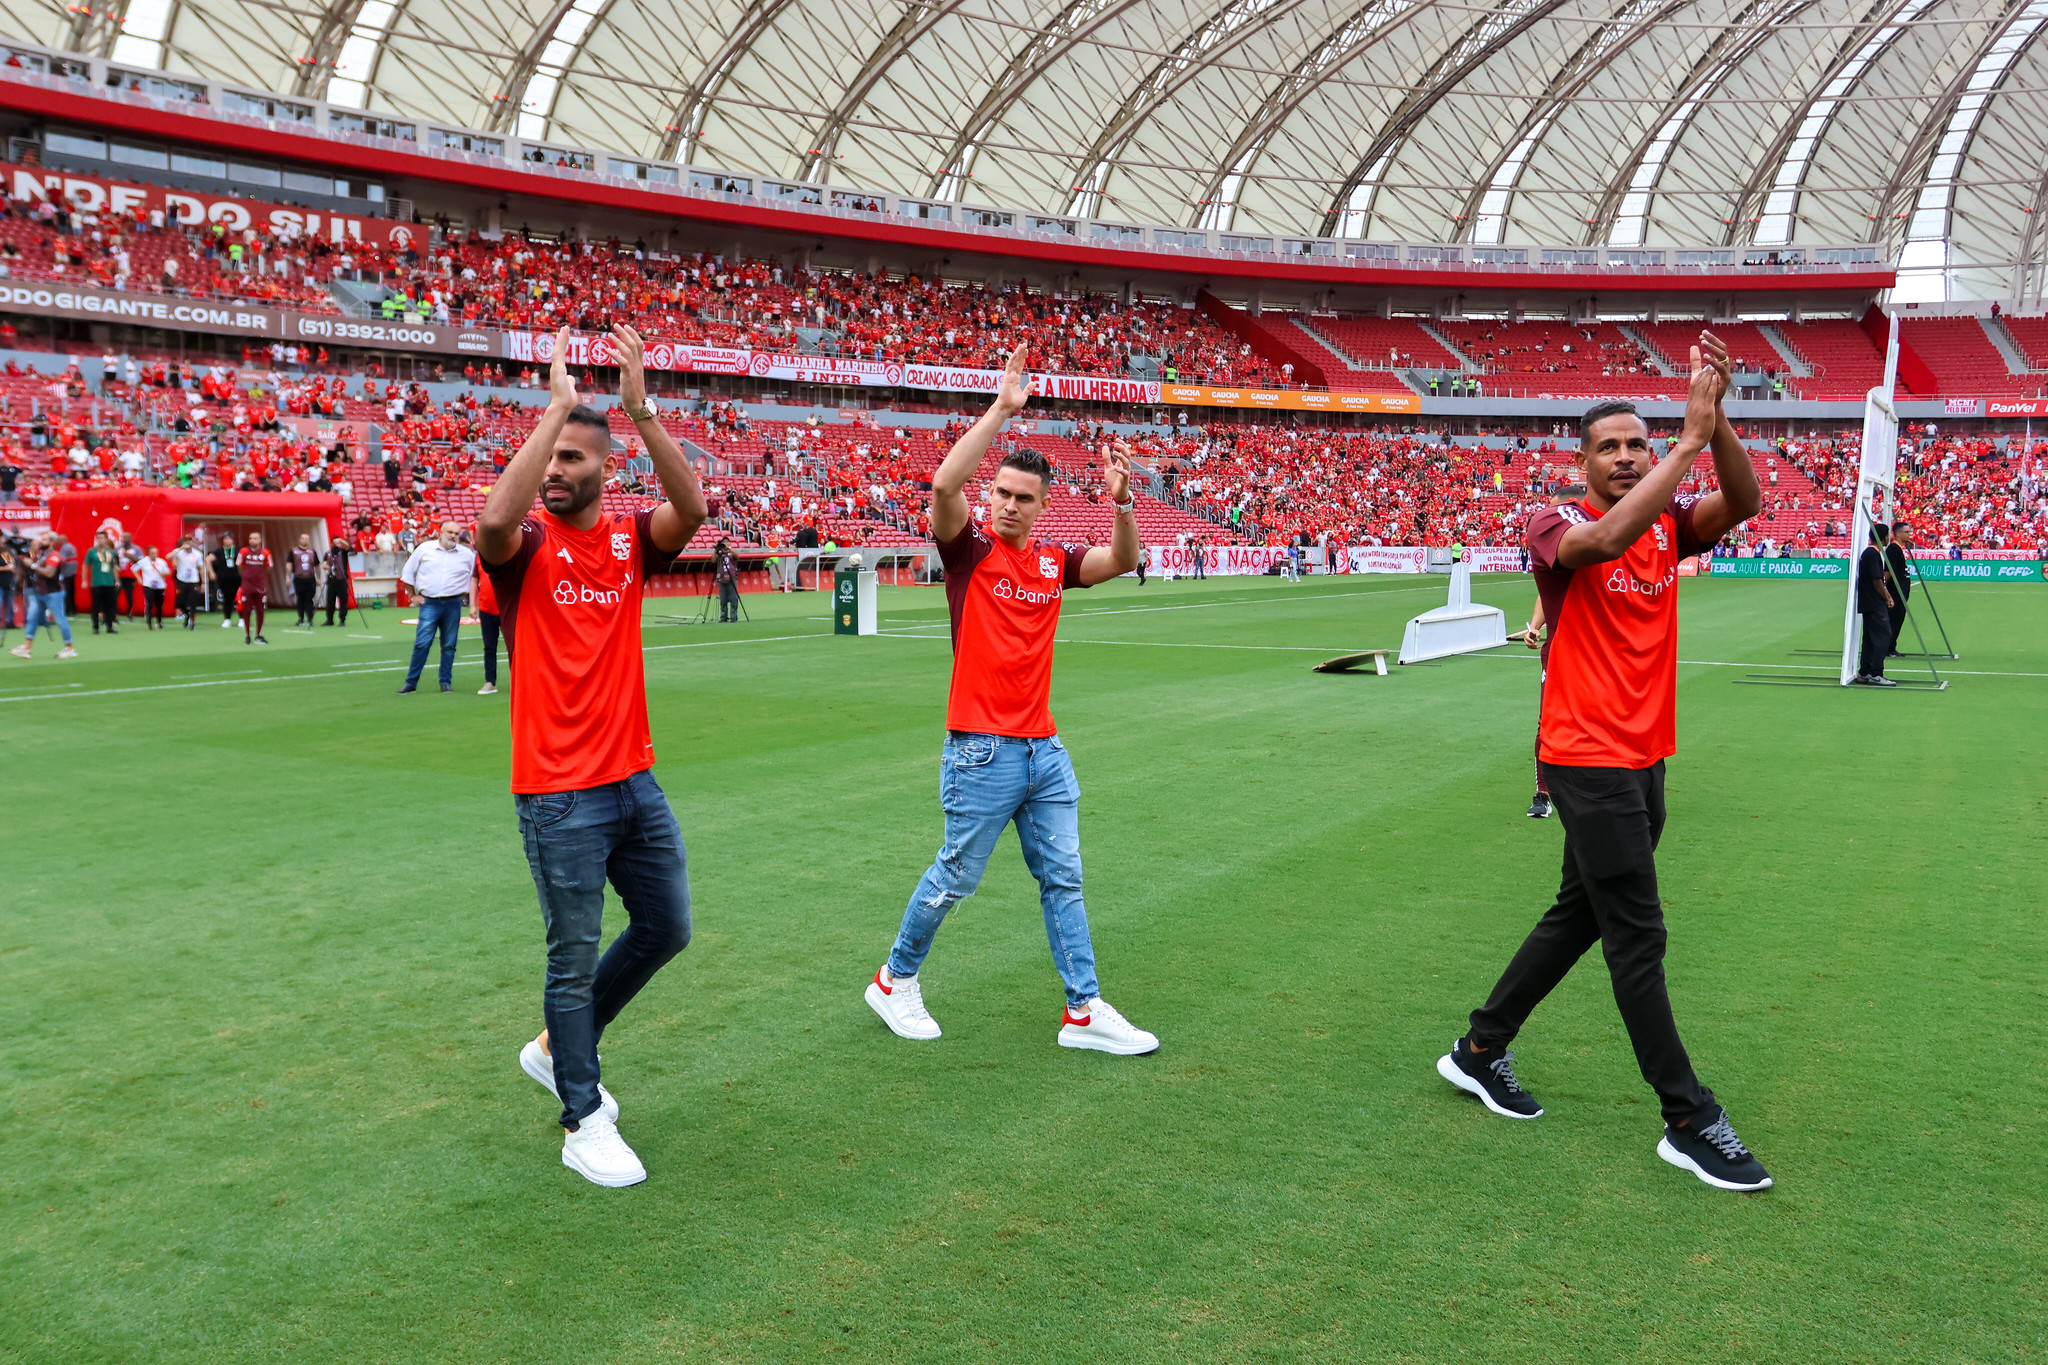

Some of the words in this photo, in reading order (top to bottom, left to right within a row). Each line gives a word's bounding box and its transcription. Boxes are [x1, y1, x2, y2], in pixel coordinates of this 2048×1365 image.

[165, 193, 251, 231] DO
[298, 318, 332, 337] (51)
[334, 322, 436, 345] 3392.1000
[772, 354, 832, 371] SALDANHA
[835, 359, 885, 375] MARINHO
[812, 372, 861, 385] INTER
[907, 369, 948, 389] CRIANÇA
[950, 372, 998, 390] COLORADA
[1044, 378, 1055, 397] A
[1058, 379, 1148, 403] MULHERADA
[1172, 388, 1200, 397] GAUCHA
[1211, 391, 1240, 399] GAUCHA
[1251, 393, 1279, 401] GAUCHA
[1301, 395, 1330, 403] GAUCHA
[1341, 397, 1370, 405] GAUCHA
[1381, 398, 1409, 406] GAUCHA
[1989, 403, 2037, 413] PanVel
[1739, 563, 1759, 574] AQUI
[1760, 560, 1766, 573] É
[1769, 561, 1803, 574] PAIXÃO
[1920, 564, 1941, 576] AQUI
[1944, 562, 1950, 576] É
[1953, 563, 1991, 577] PAIXÃO
